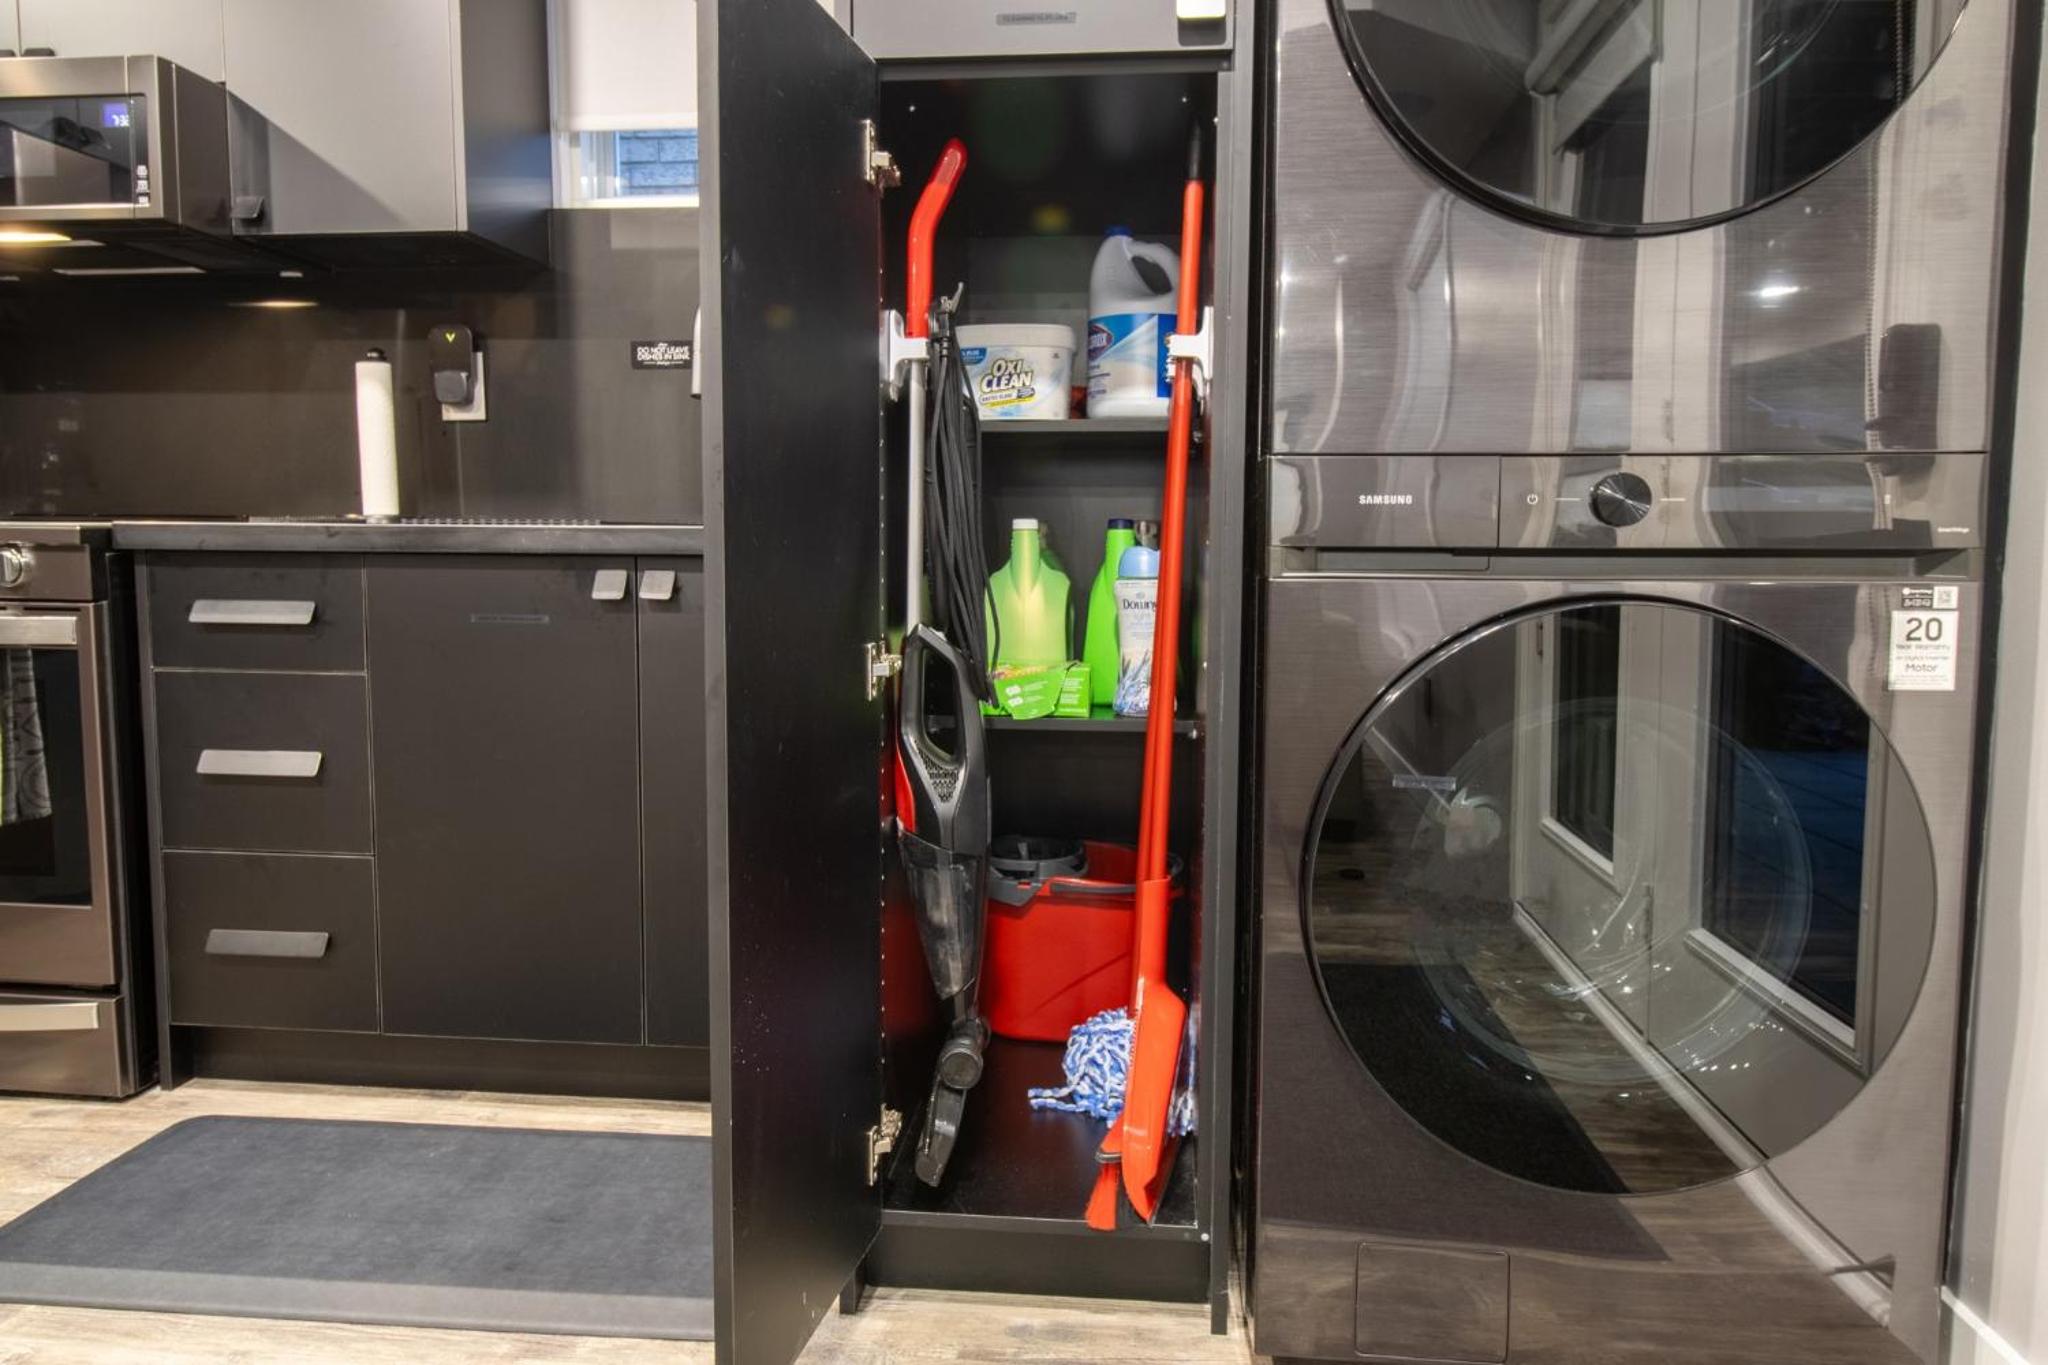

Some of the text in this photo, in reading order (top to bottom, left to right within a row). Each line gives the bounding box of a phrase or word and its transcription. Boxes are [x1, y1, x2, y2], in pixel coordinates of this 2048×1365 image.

[667, 345, 689, 353] LEAVE
[992, 358, 1023, 376] OXI
[981, 371, 1033, 393] CLEAN
[1359, 494, 1413, 504] SAMSUNG
[1122, 598, 1157, 613] Downy
[1905, 616, 1943, 642] 20
[1905, 662, 1938, 673] Motor
